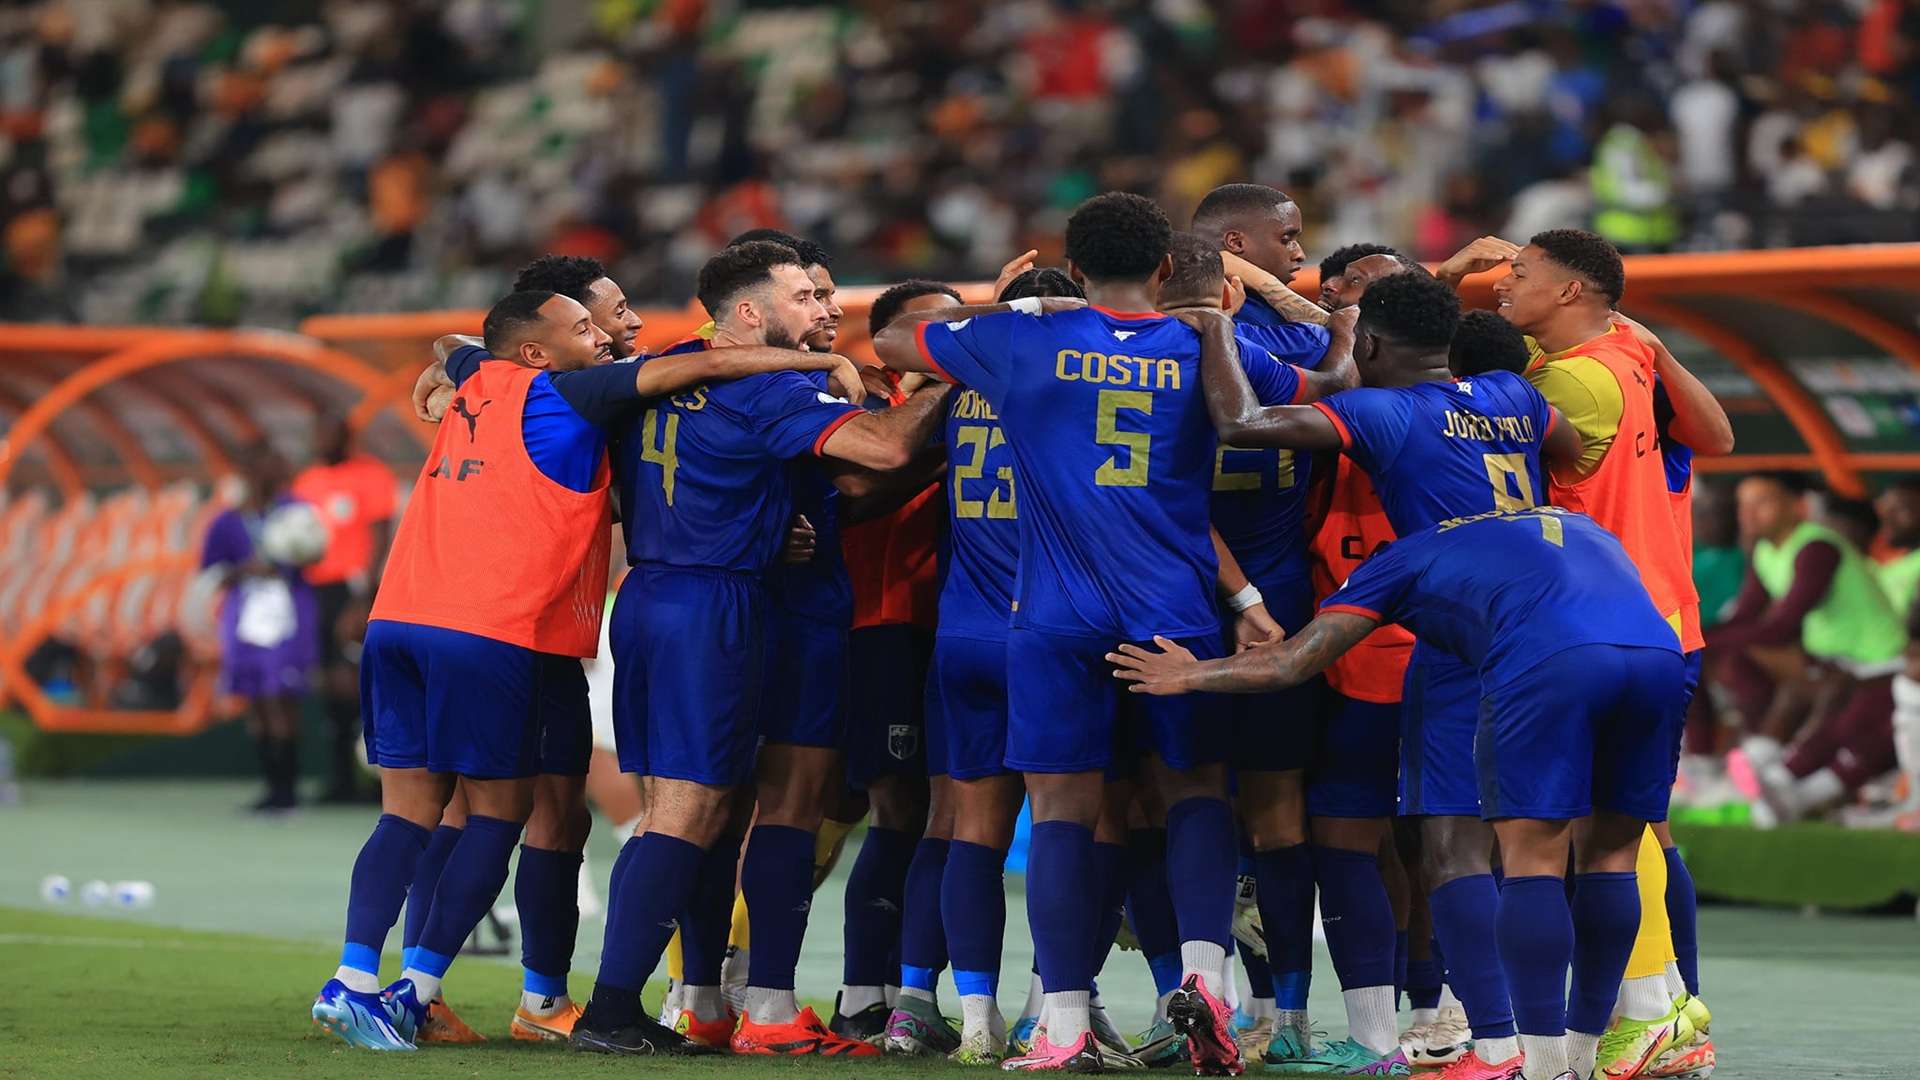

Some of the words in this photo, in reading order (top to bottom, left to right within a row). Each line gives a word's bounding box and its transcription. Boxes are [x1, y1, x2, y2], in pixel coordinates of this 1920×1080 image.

[1055, 349, 1181, 390] COSTA
[641, 408, 681, 508] 4
[954, 425, 1019, 520] 23
[1095, 389, 1154, 487] 5
